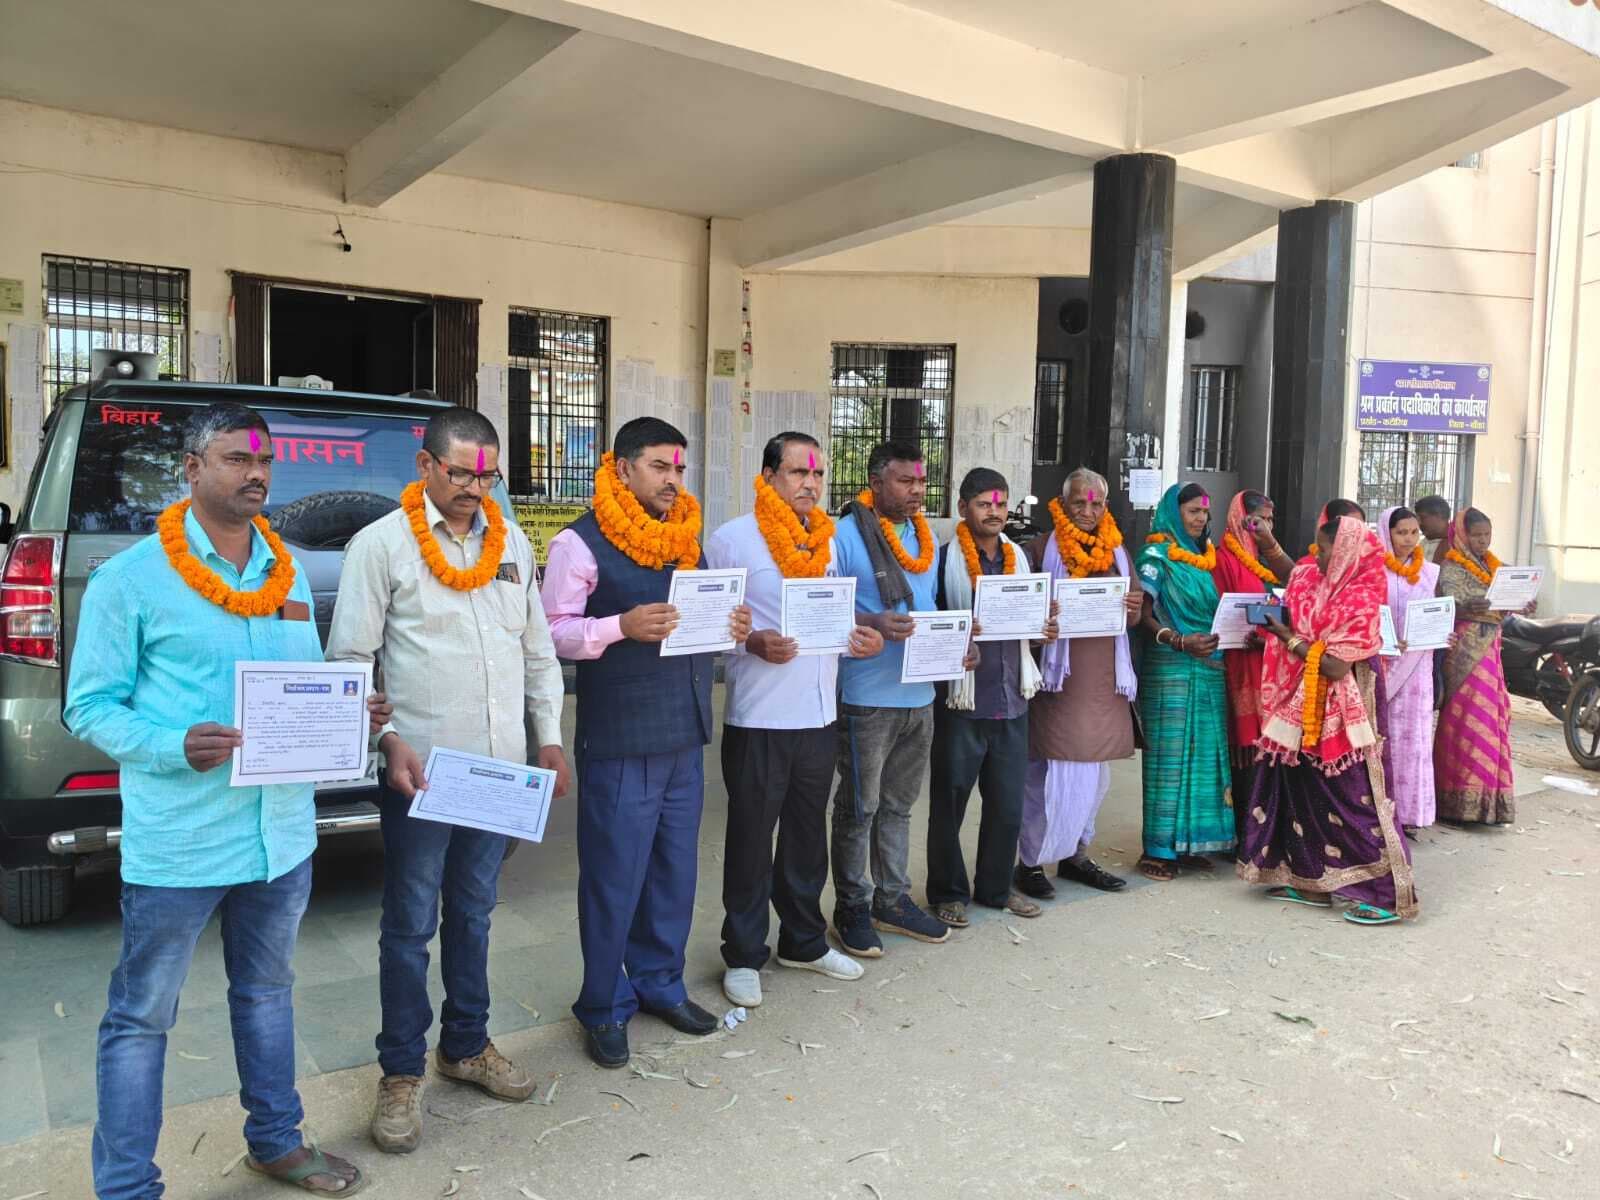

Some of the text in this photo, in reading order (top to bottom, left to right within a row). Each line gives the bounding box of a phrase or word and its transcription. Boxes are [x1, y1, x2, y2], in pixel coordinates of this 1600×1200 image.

[101, 404, 162, 426] बिहार
[1360, 395, 1375, 414] श्रम
[1400, 392, 1440, 416] पदाधिकारी
[1441, 398, 1453, 417] का
[1454, 393, 1487, 418] कार्यालय
